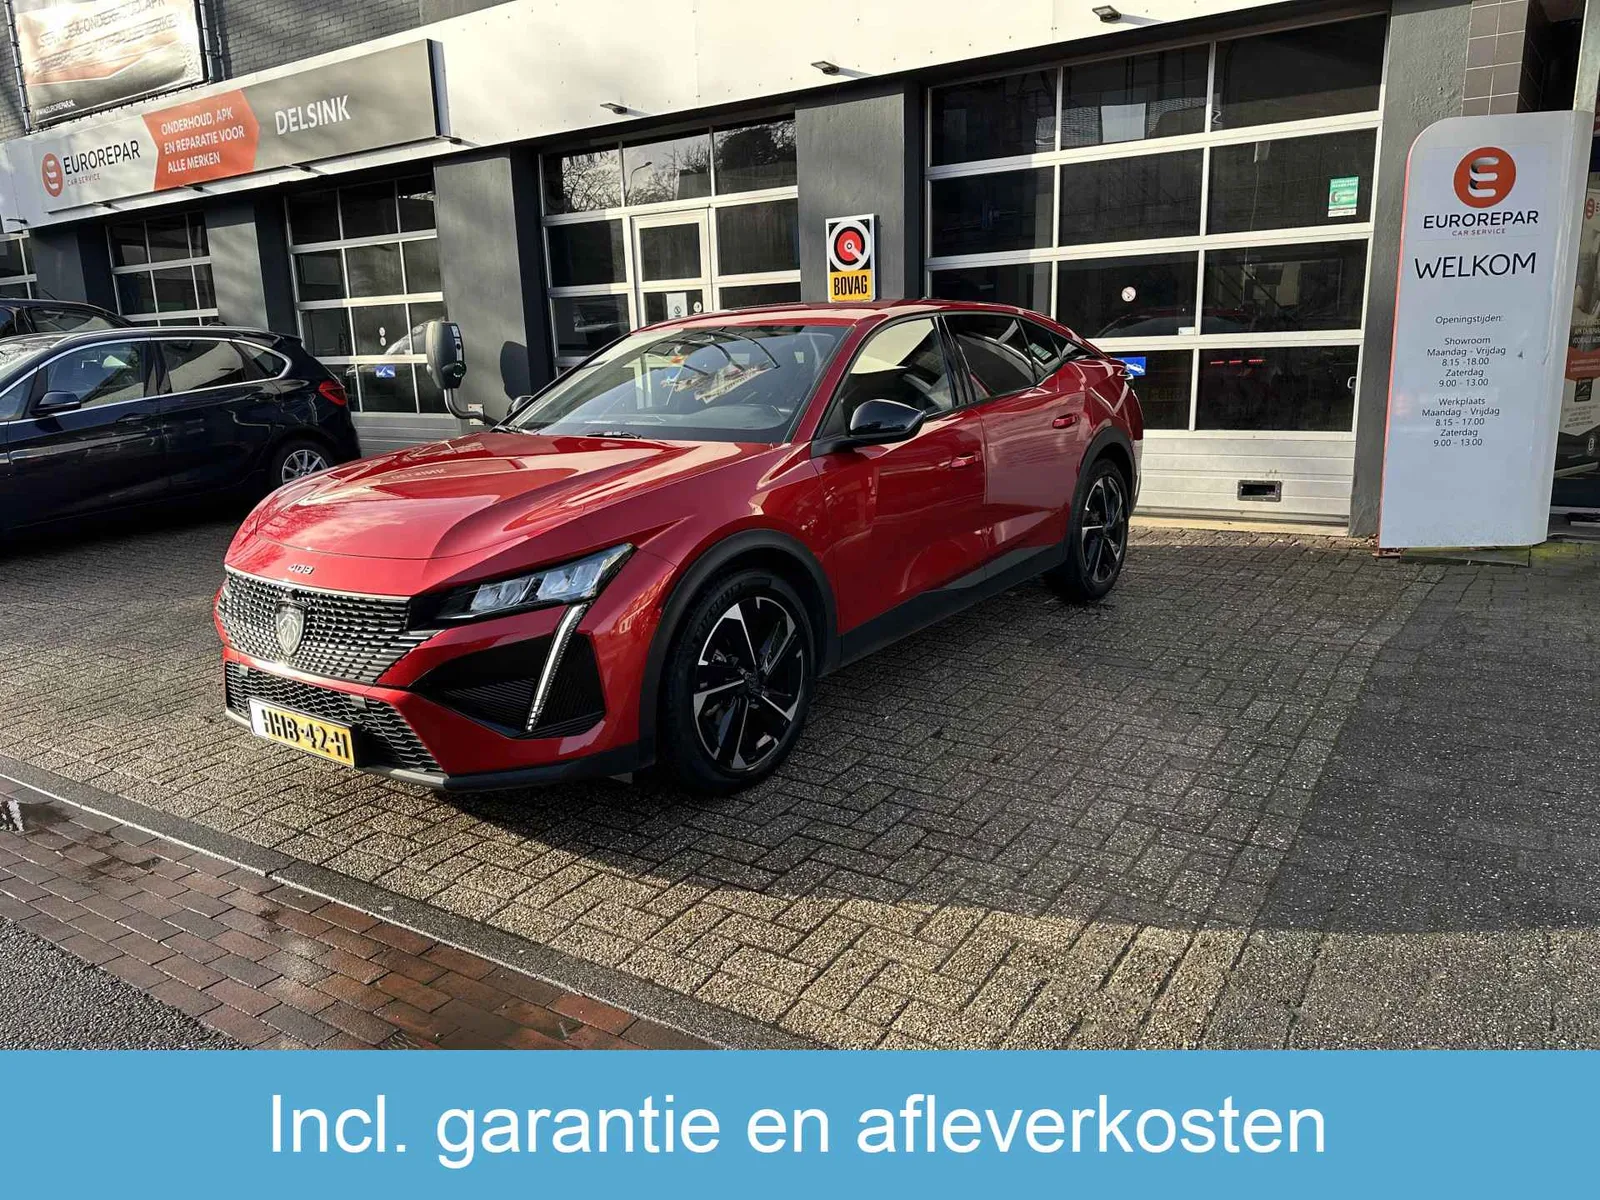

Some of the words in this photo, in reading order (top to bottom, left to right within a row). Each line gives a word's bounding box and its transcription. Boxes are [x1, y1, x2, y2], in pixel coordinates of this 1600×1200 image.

[275, 95, 351, 135] DELSINK
[161, 112, 215, 136] ONDERHOUD,
[216, 107, 234, 122] APK
[164, 142, 176, 155] EN
[176, 131, 219, 152] REPARATIE
[218, 124, 245, 142] VOOR
[62, 140, 140, 175] EUROREPAR
[167, 159, 187, 174] ALLE
[187, 152, 220, 170] MERKEN
[67, 178, 77, 187] CAR
[78, 173, 101, 185] SERVICE
[1423, 210, 1539, 229] EUROREPAR
[1471, 228, 1506, 236] SERVICE
[1415, 252, 1537, 279] WELKOM
[833, 275, 868, 296] BOVAG
[1444, 337, 1491, 345] Showroom
[1427, 348, 1467, 357] Maandag
[1476, 346, 1506, 357] Vrijdag
[1441, 358, 1460, 366] 8.15
[1445, 368, 1484, 377] Zaterdag
[1438, 379, 1457, 387] 9.00
[1466, 378, 1489, 387] 13.00
[1438, 397, 1486, 407] Werkplaats
[1422, 408, 1461, 417] Maandag
[1470, 407, 1500, 416] Vrijdag
[1435, 418, 1453, 426] 8.15
[1462, 417, 1485, 426] 17.00
[1440, 428, 1478, 437] Zaterdag
[1433, 439, 1451, 447] 9.00
[1461, 438, 1483, 446] 13.00
